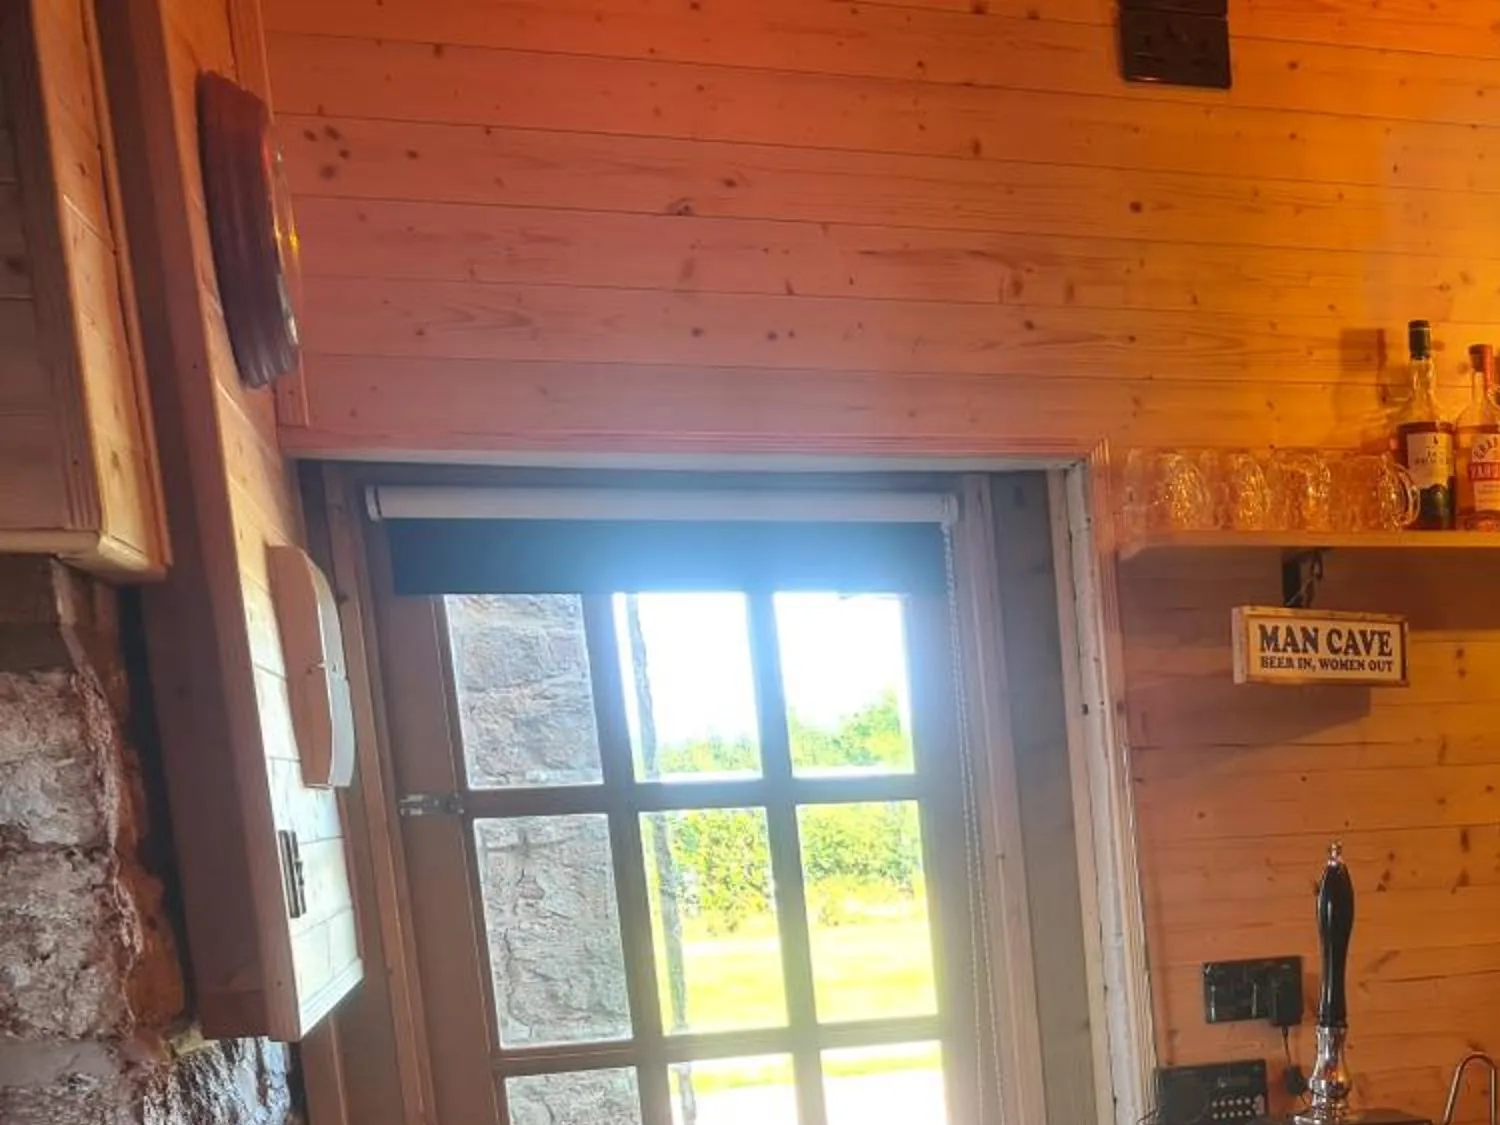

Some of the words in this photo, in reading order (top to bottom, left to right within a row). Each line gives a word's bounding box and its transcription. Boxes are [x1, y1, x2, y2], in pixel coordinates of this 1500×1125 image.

[1258, 623, 1319, 654] MAN
[1326, 627, 1393, 657] CAVE
[1260, 655, 1295, 669] BEER
[1319, 657, 1366, 672] WOMEN
[1369, 659, 1393, 672] OUT
